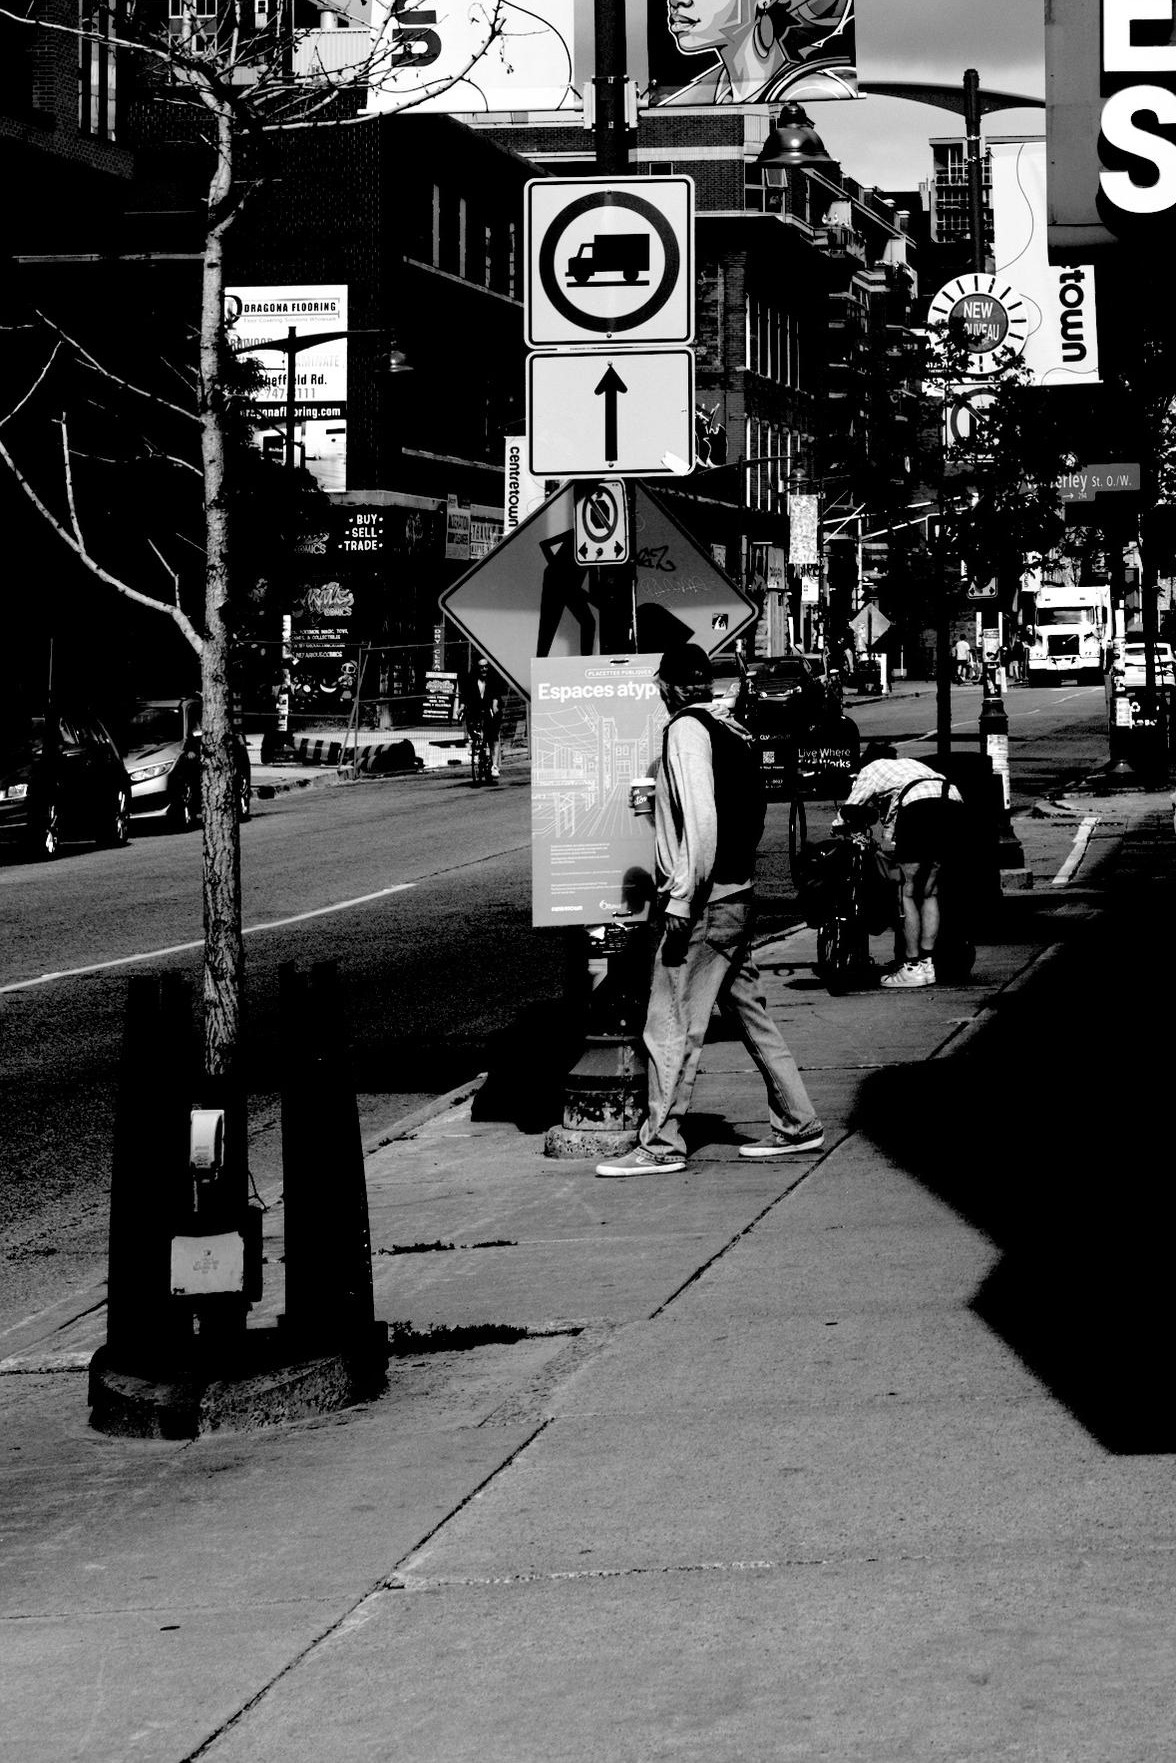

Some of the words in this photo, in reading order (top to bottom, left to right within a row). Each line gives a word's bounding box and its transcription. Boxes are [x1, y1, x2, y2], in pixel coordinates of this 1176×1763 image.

[244, 303, 288, 313] DRAGONA
[291, 302, 336, 312] FLOORING
[963, 301, 994, 319] NEW
[961, 322, 1000, 342] OUVEAU
[311, 373, 328, 385] Rd.
[508, 446, 520, 527] centretown
[356, 514, 378, 525] BUY
[351, 526, 378, 538] SELL
[343, 539, 378, 551] TRADE
[538, 682, 614, 703] Espaces
[798, 747, 818, 758] Live
[819, 747, 851, 758] Where
